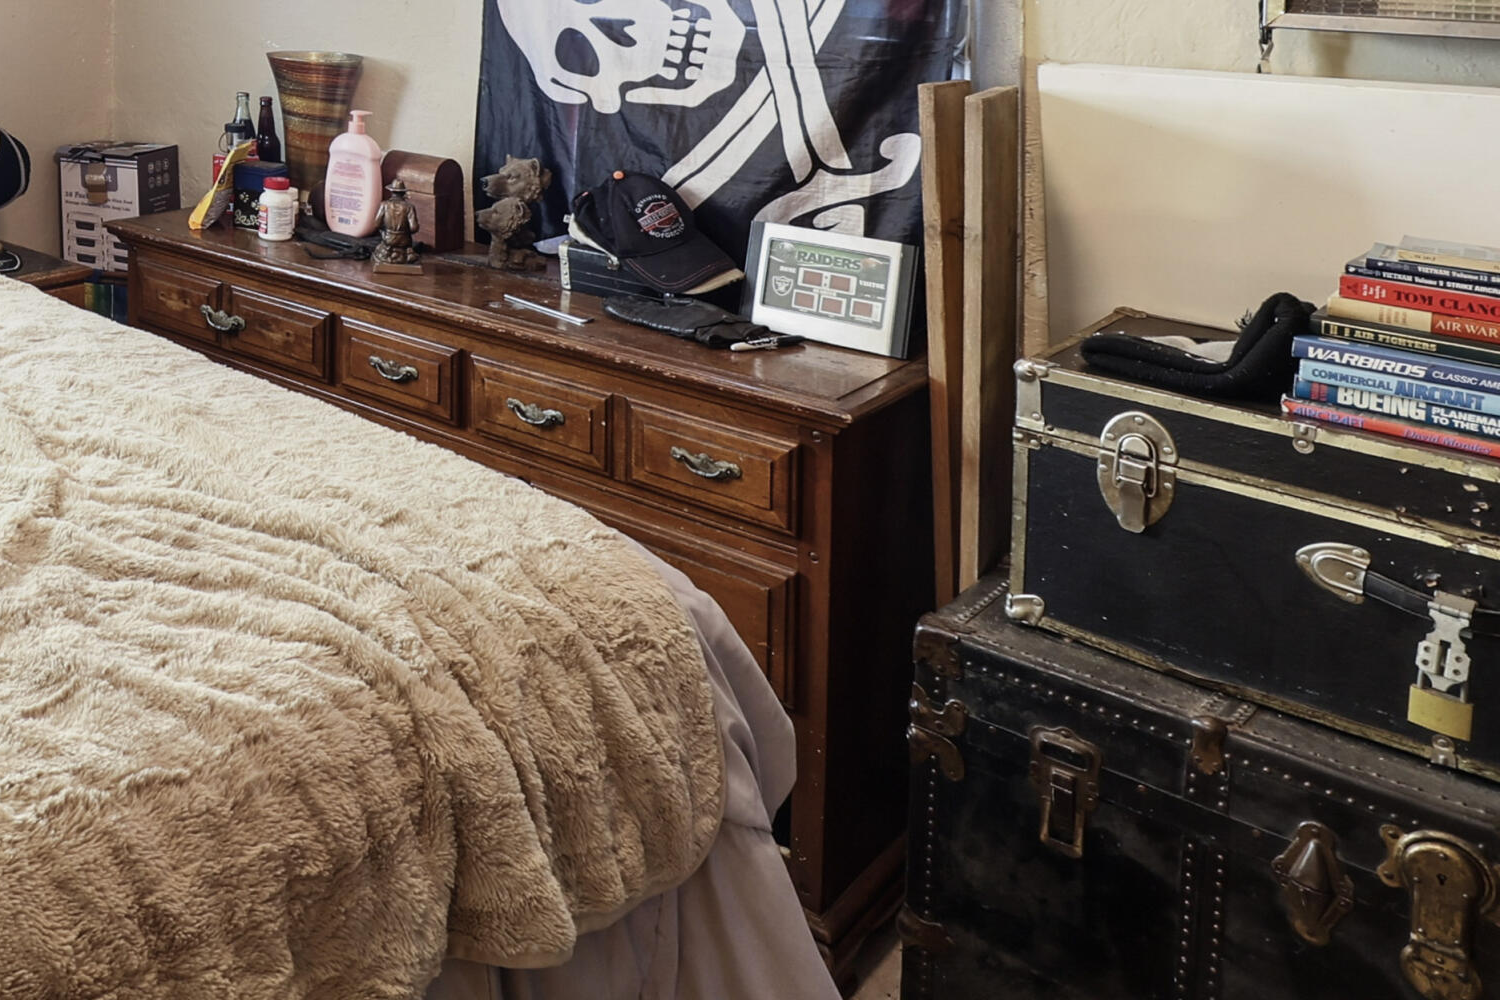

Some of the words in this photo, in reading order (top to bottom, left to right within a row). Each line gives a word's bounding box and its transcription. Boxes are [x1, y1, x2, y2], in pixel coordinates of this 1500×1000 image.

[796, 249, 861, 271] RAIDERS
[1382, 271, 1413, 282] VIETNAM
[1393, 289, 1434, 307] TOM
[1434, 319, 1462, 333] AIR
[1378, 334, 1438, 352] FIGHTERS
[1307, 346, 1428, 379] WARBIRDS
[1432, 370, 1479, 386] CLASSIC
[1311, 368, 1393, 392] COMMERCIAL
[1394, 380, 1487, 411] AIRCRAFT
[1336, 385, 1427, 421] BOEING
[1292, 406, 1365, 429] AIRCRAFT
[1431, 414, 1450, 426] TO
[1452, 419, 1479, 432] THE
